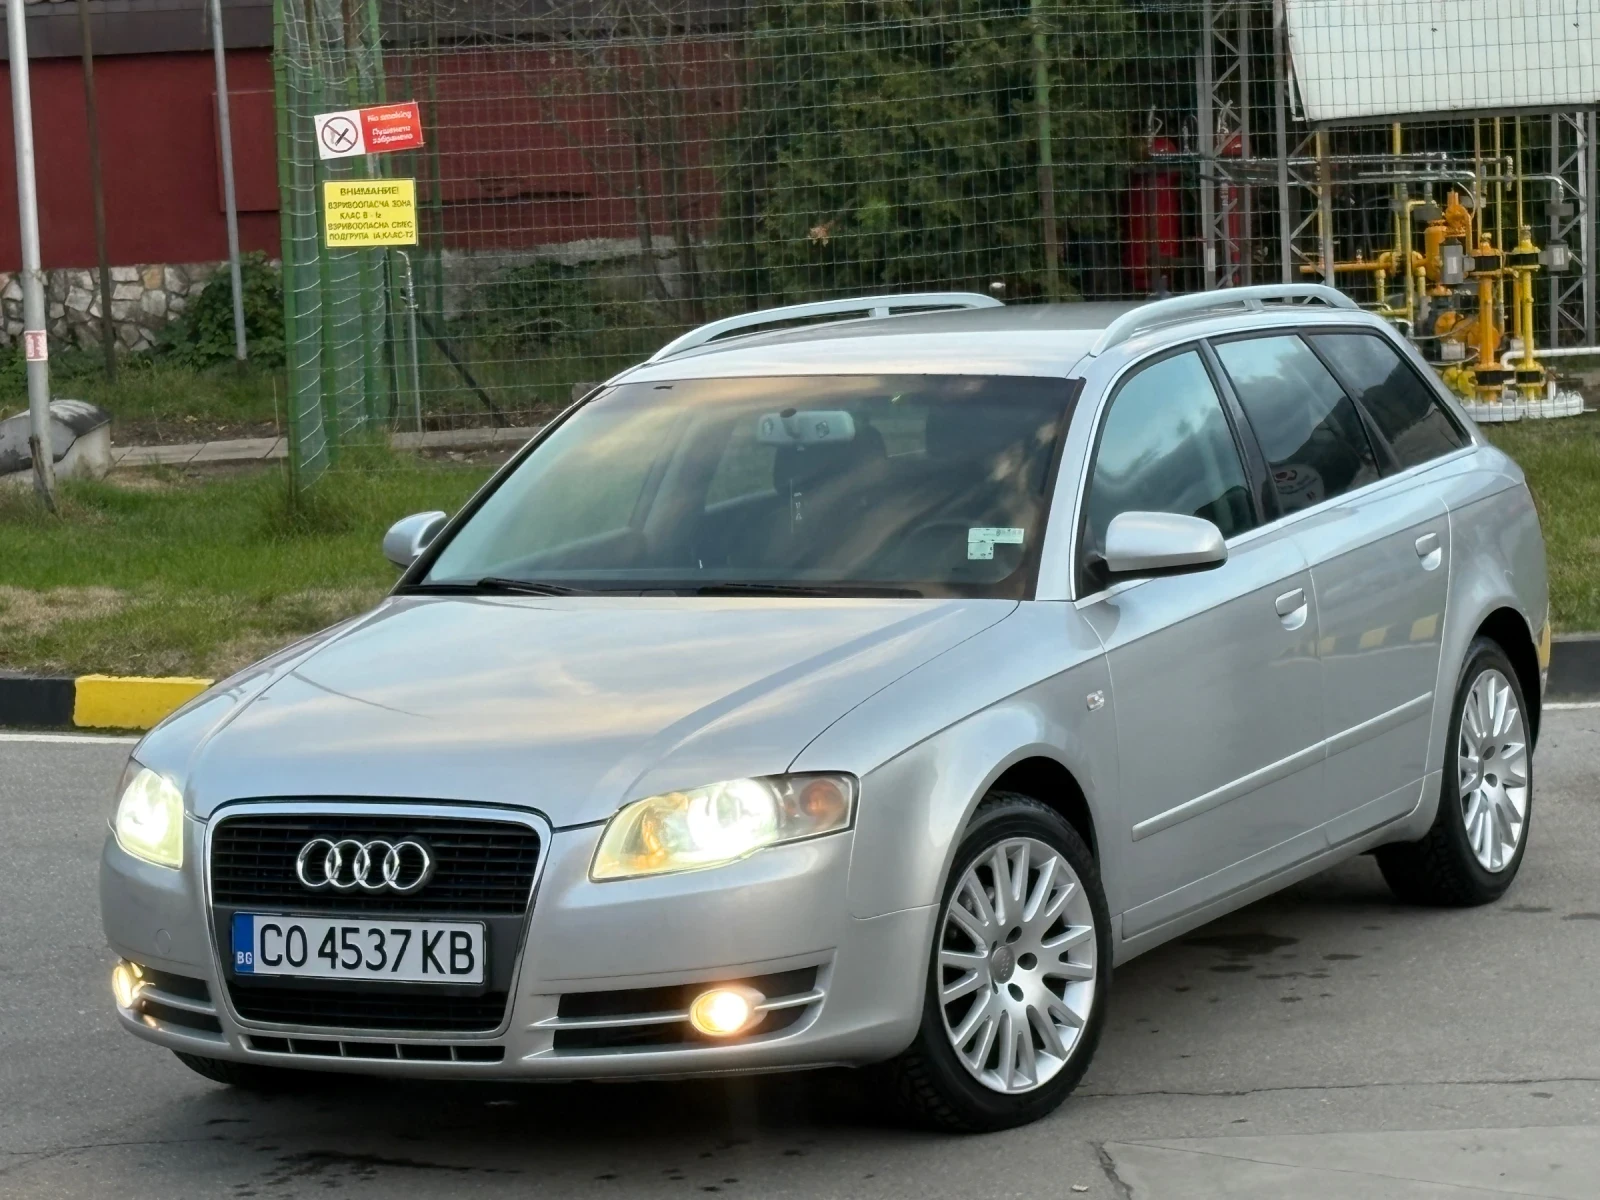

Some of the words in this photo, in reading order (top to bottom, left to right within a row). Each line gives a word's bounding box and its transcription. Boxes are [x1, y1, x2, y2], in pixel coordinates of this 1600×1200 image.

[367, 114, 379, 122] No
[380, 111, 412, 121] smoking
[260, 923, 308, 968] CO
[318, 926, 412, 973] 4537
[421, 929, 475, 975] KB
[237, 951, 253, 965] BG
